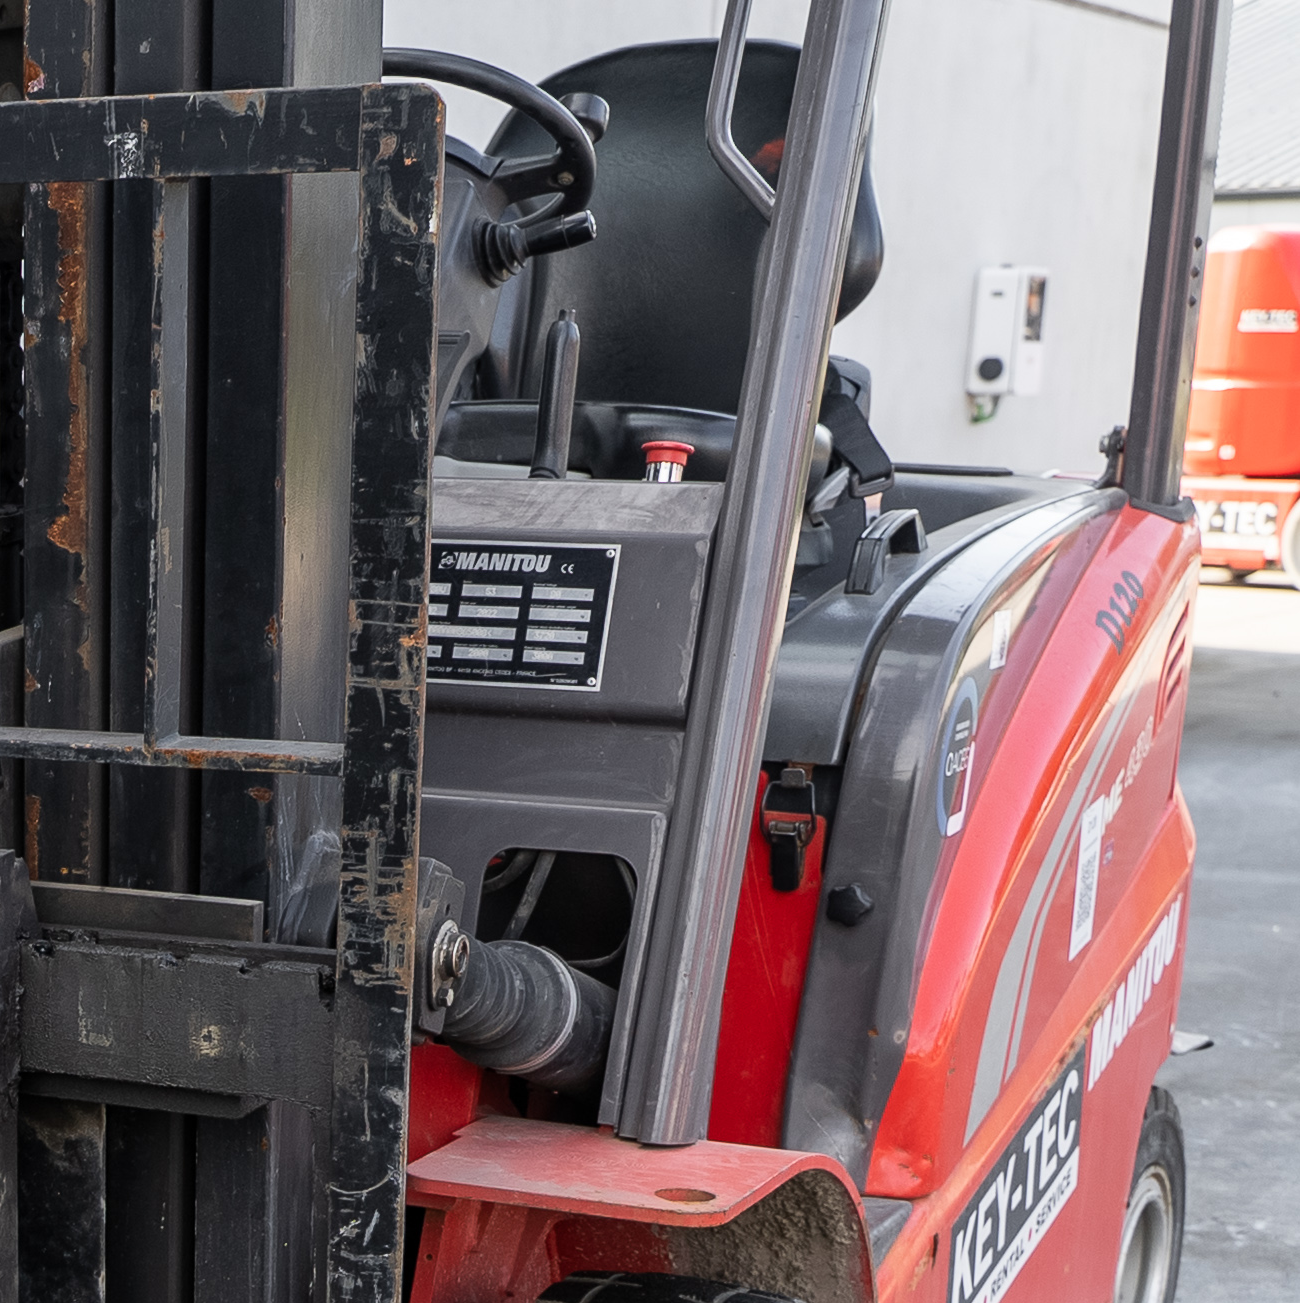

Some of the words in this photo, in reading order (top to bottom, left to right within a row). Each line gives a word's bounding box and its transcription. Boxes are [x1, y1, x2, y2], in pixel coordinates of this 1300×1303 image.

[1194, 501, 1278, 534] Y-TEC
[455, 552, 552, 572] MANITOU
[560, 563, 575, 574] CE
[1095, 570, 1144, 655] D120
[1087, 892, 1182, 1092] MANITOU
[990, 1237, 1026, 1300] RENTAL
[1034, 1166, 1073, 1234] SERVICE
